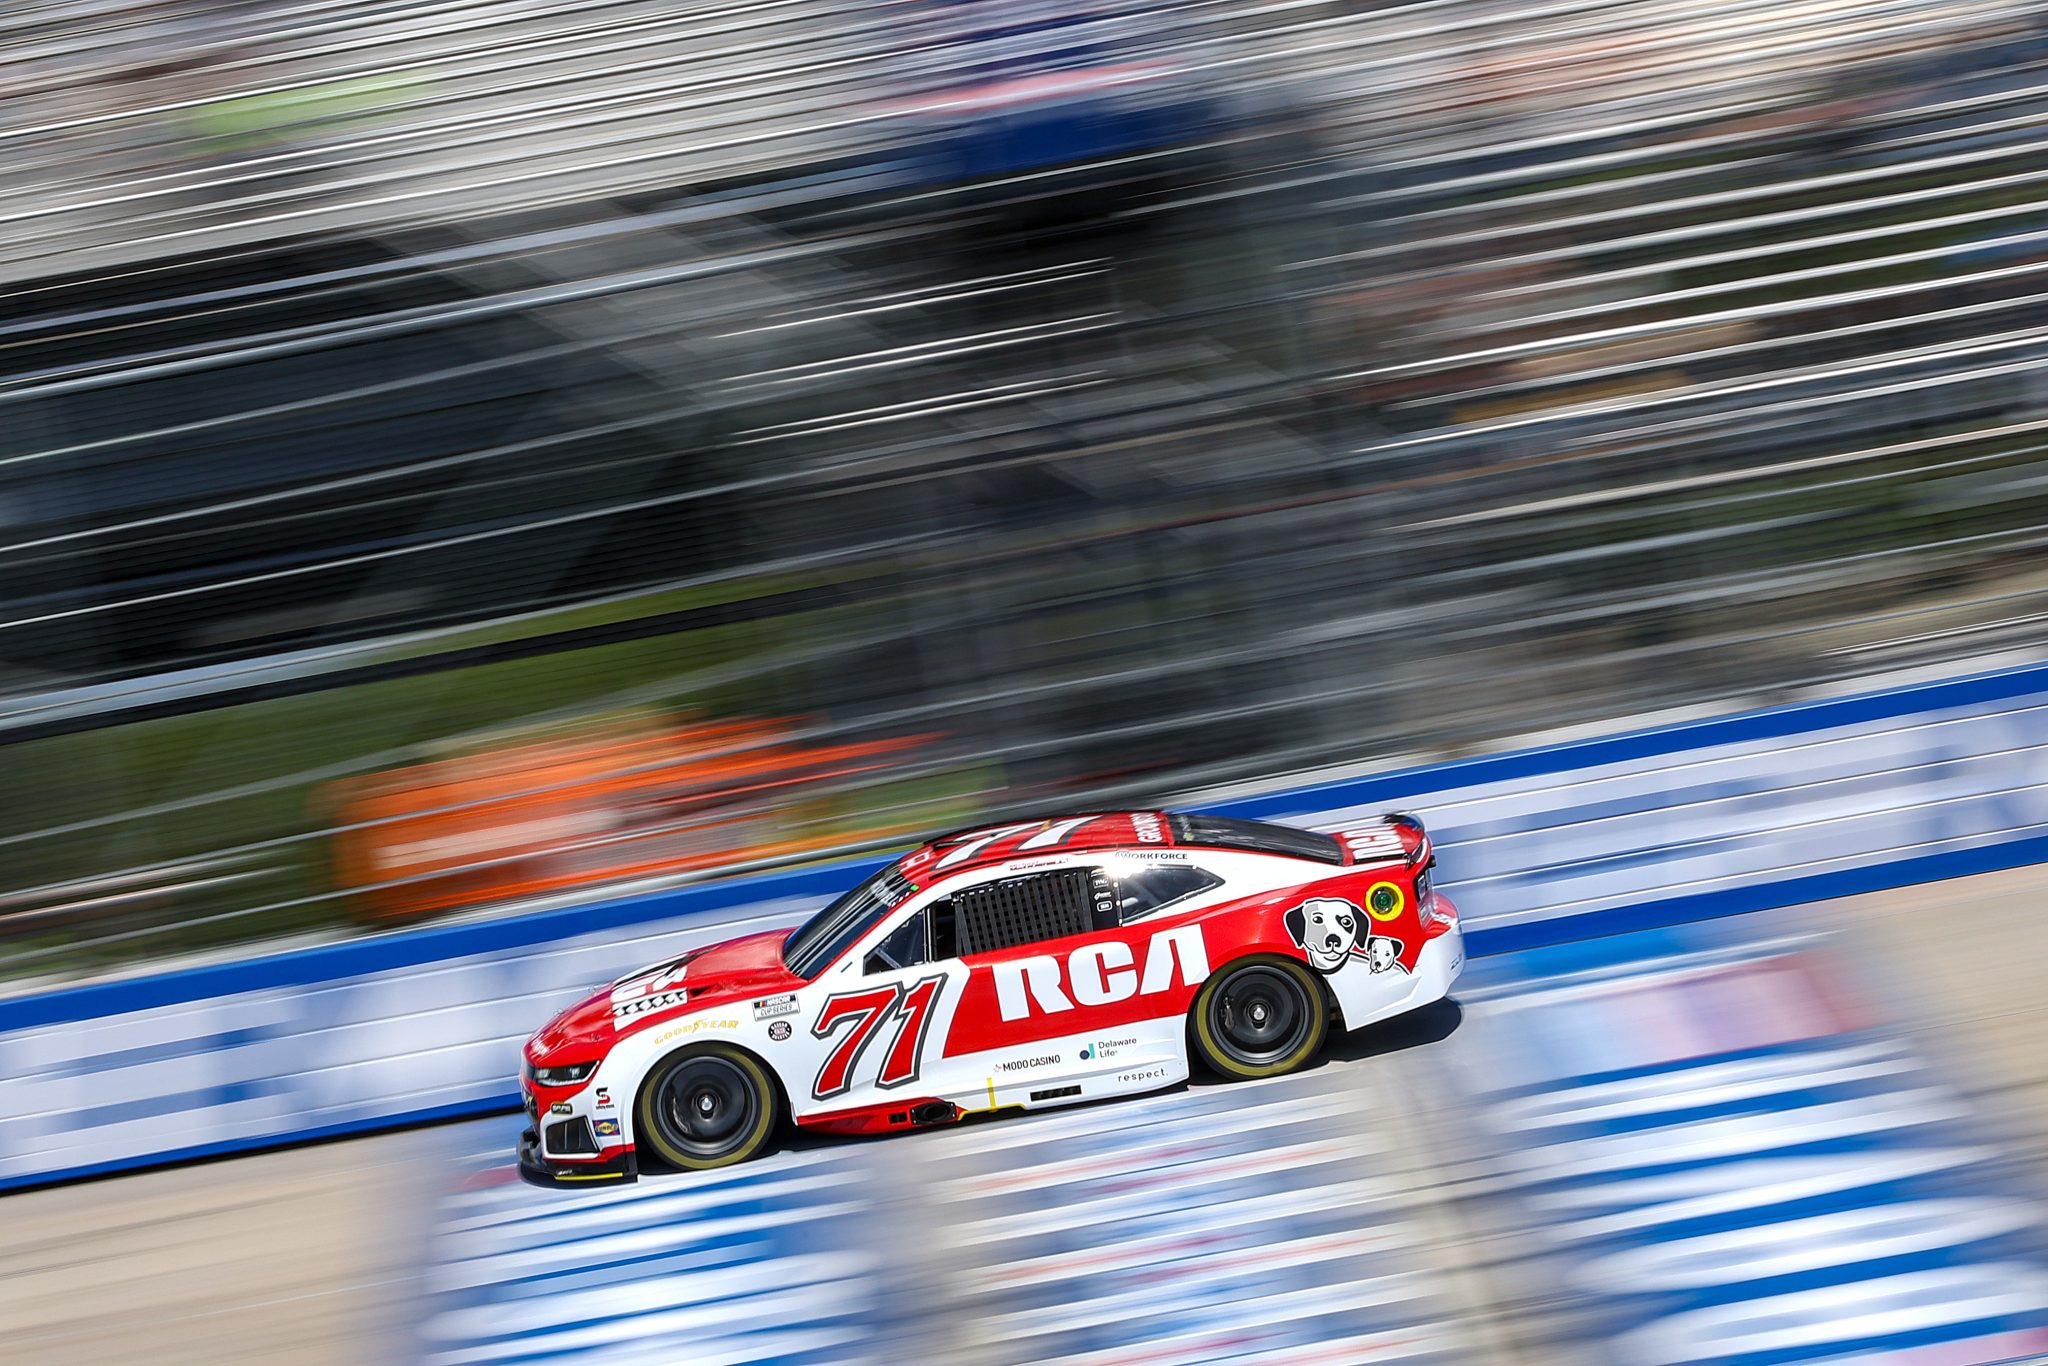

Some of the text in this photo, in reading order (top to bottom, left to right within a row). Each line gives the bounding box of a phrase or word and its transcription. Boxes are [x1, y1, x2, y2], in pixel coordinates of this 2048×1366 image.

[992, 924, 1212, 1022] RCA
[654, 1018, 740, 1045] GOODYEAR
[810, 972, 949, 1102] 71
[1098, 1038, 1137, 1049] Delaware
[1003, 1054, 1061, 1072] MODO CASINO
